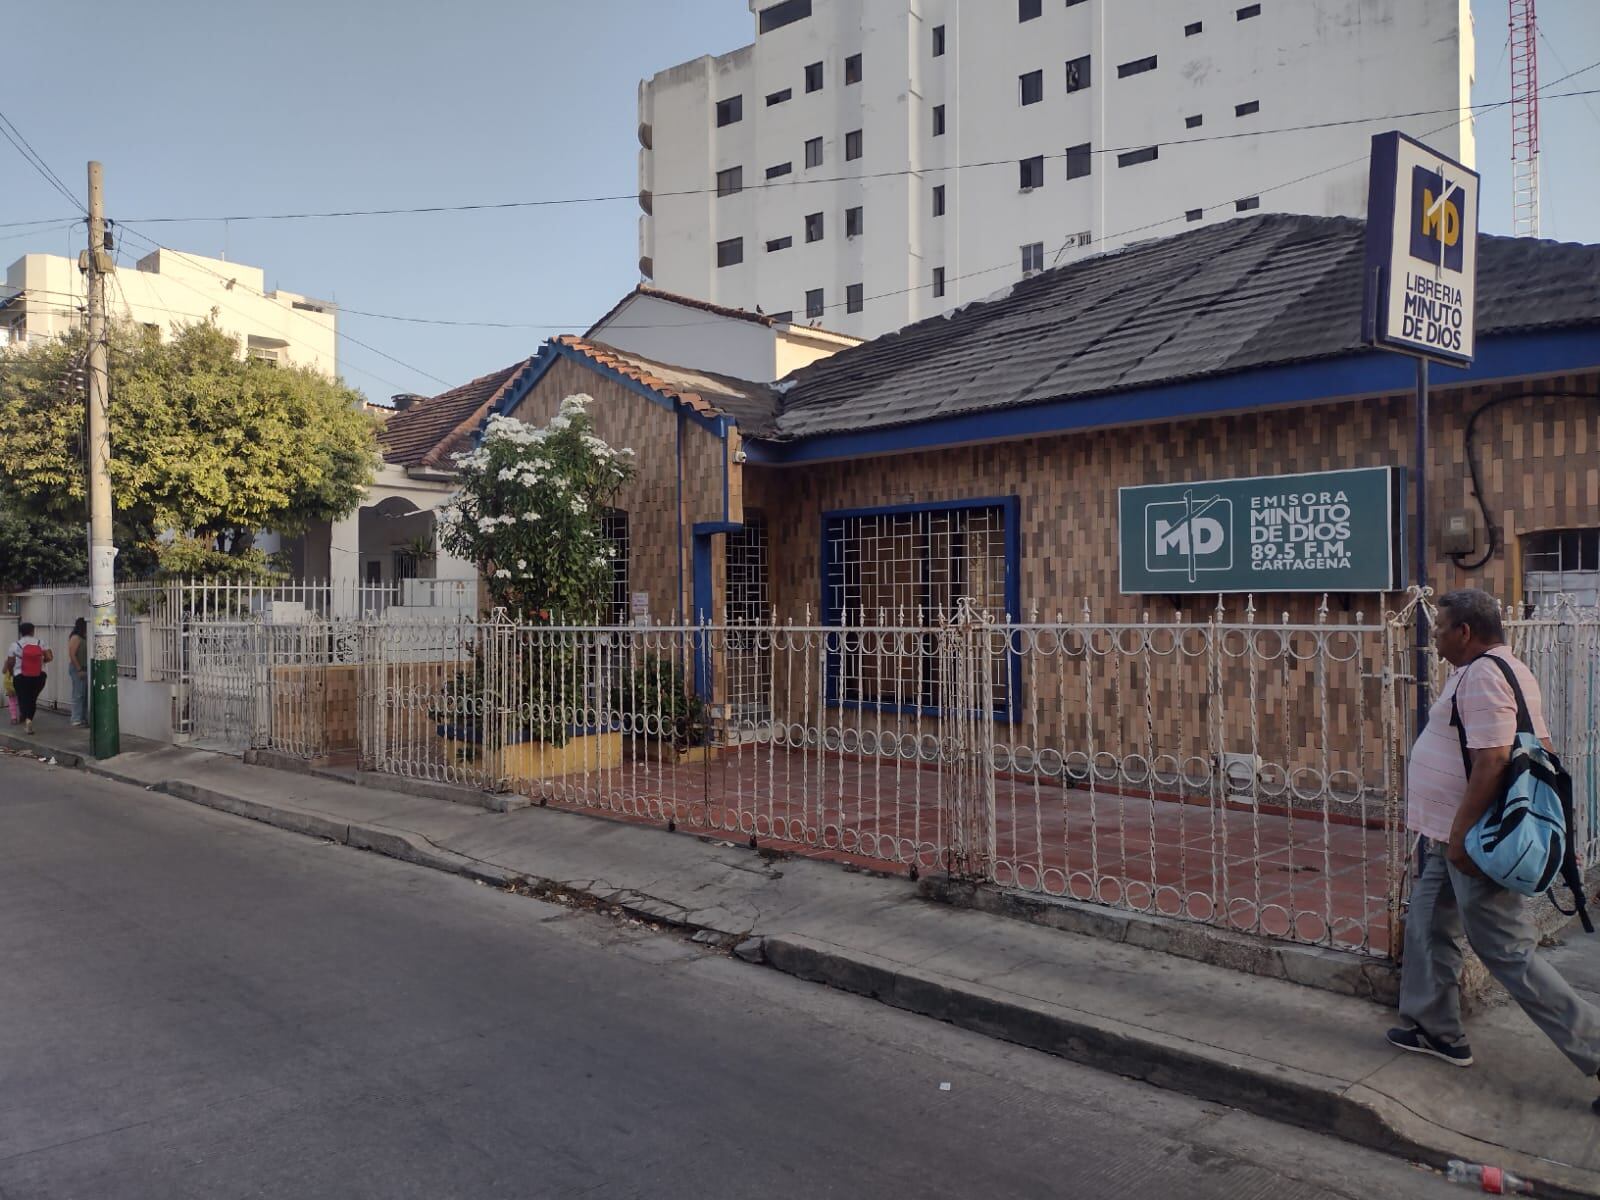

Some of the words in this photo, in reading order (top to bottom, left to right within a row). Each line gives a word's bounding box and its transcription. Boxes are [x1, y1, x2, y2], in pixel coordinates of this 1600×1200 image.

[1406, 272, 1462, 307] LIBRERIA
[1404, 292, 1462, 328] MINUTO
[1402, 318, 1422, 340] DE
[1426, 322, 1461, 350] DIOS
[1251, 491, 1348, 508] EMISORA
[1251, 504, 1350, 526] MINUTO
[1156, 517, 1224, 555] MD
[1251, 525, 1282, 544] DE
[1289, 522, 1350, 541] DIOS
[1251, 543, 1295, 560] 89.5
[1304, 541, 1351, 558] F.M.
[1251, 558, 1350, 571] CARTAGENA
